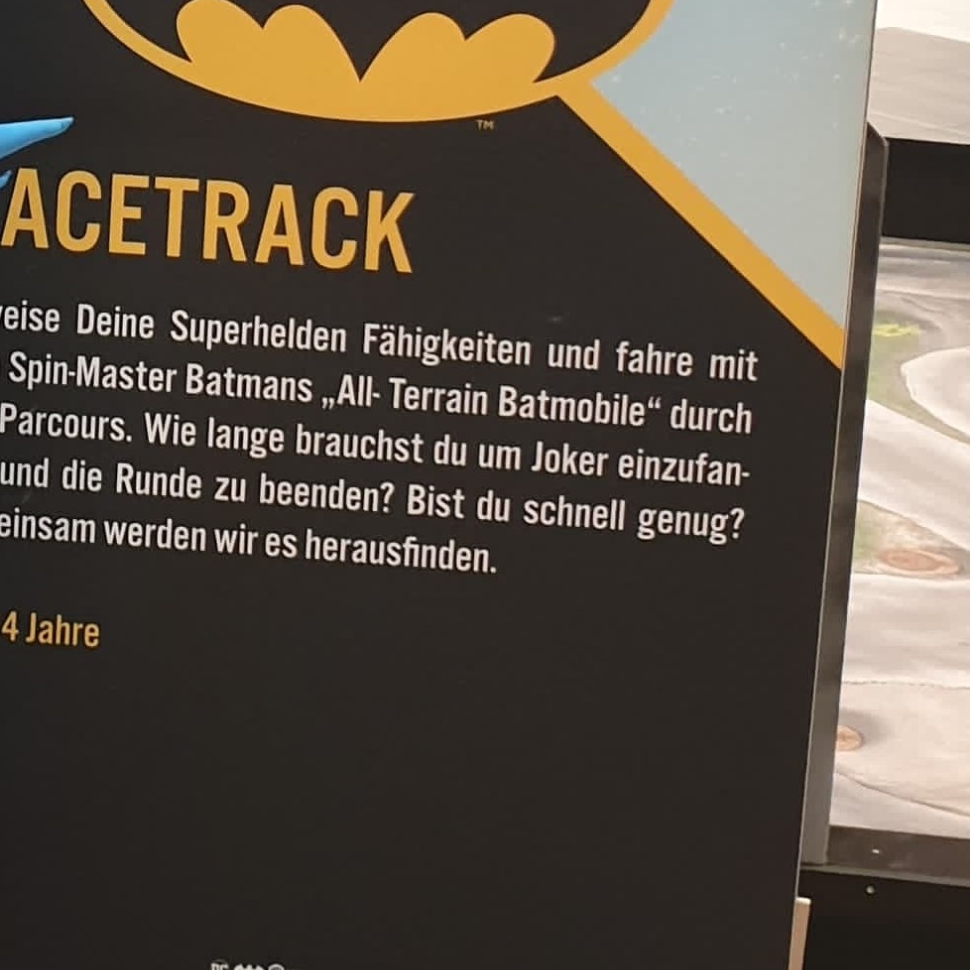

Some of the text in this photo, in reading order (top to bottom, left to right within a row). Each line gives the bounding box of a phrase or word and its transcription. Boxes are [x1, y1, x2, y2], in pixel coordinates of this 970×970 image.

[76, 303, 155, 339] Deine
[170, 309, 347, 353] Superhelden
[363, 323, 531, 367] Fähigkeiten
[548, 339, 600, 370] und
[616, 340, 693, 377] fahre
[709, 348, 759, 382] mit
[8, 351, 178, 393] Spin-Master
[185, 363, 313, 403] Batmans
[322, 374, 381, 409] „All-
[388, 377, 488, 416] Terrain
[670, 398, 752, 434] durch
[0, 402, 132, 442] Parcours.
[144, 412, 197, 447] Wie
[207, 416, 285, 459] lange
[296, 423, 424, 464] brauchst
[433, 433, 467, 467] du
[478, 444, 521, 471] um
[531, 441, 609, 477] Joker
[618, 448, 750, 486] einzufan-
[0, 457, 49, 488] und
[62, 459, 102, 492] die
[116, 462, 202, 499] Runde
[214, 476, 246, 503] zu
[259, 472, 395, 513] beenden?
[407, 483, 465, 519] Bist
[477, 489, 511, 522] du
[523, 494, 626, 531] schnell
[637, 507, 745, 545] genug?
[103, 518, 207, 552] werden
[214, 523, 259, 555] wir
[265, 532, 298, 558] es
[305, 528, 497, 574] herausfinden.
[1, 611, 19, 641] 4
[25, 612, 100, 647] Jahre
